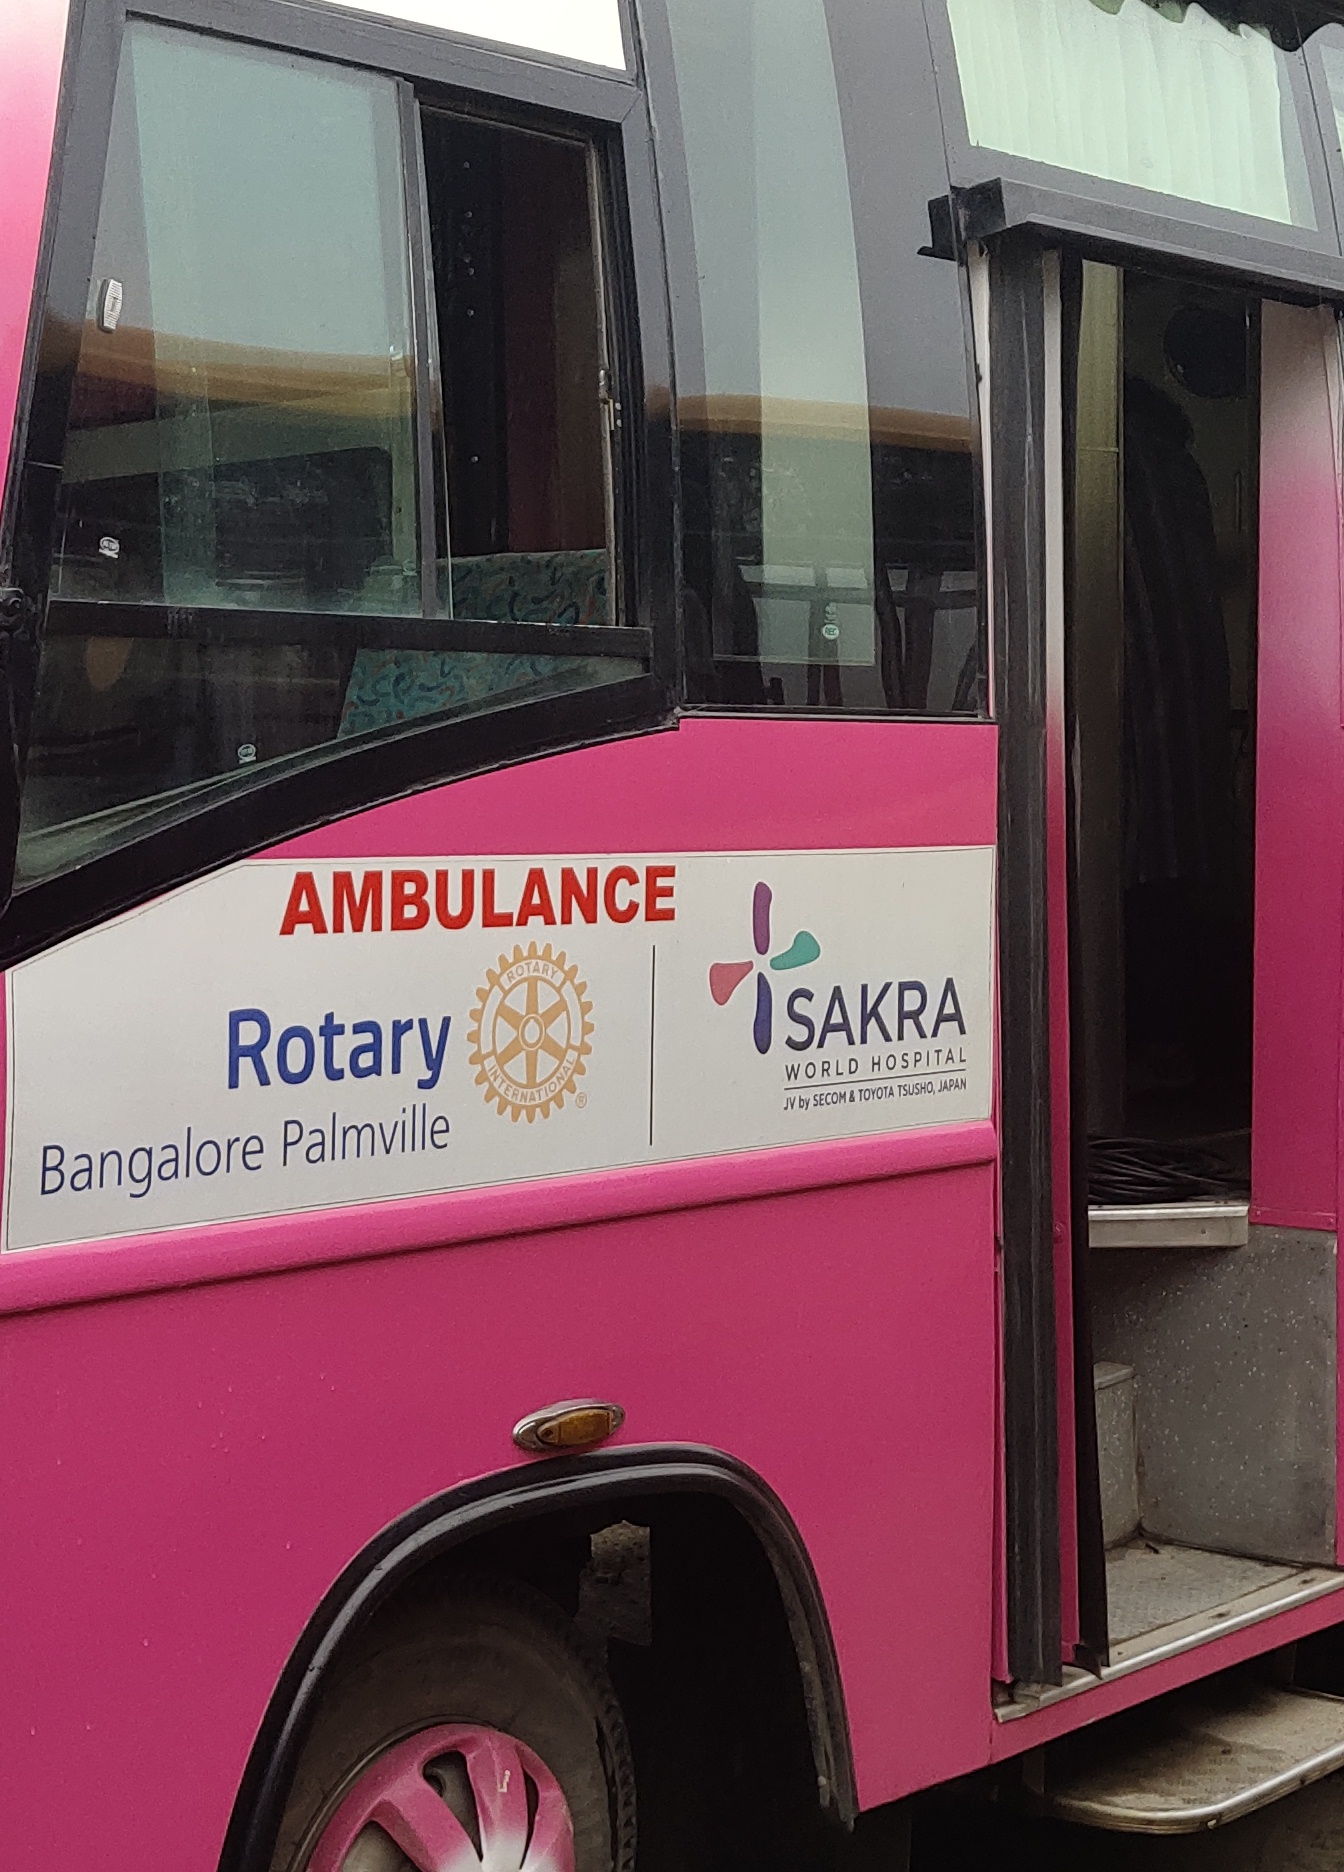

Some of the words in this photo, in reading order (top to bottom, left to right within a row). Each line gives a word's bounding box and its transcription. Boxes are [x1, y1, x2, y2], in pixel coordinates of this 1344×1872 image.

[279, 865, 676, 935] AMBULANCE
[507, 961, 559, 984] ROTARY
[785, 977, 967, 1051] SAKRA
[227, 1008, 452, 1090] Rotary
[785, 1058, 859, 1082] WORLD
[871, 1047, 967, 1072] HOSPITAL
[487, 1058, 575, 1104] INTERNATIONAL
[784, 1096, 796, 1110] JV
[798, 1093, 811, 1110] by
[813, 1091, 847, 1107] SECOM
[848, 1089, 856, 1102] &
[858, 1085, 895, 1101] TOYOTA
[897, 1080, 936, 1096] TSUSHO,
[938, 1077, 967, 1091] JAPAN
[40, 1126, 264, 1199] Bangalore
[283, 1103, 450, 1167] Palmville
